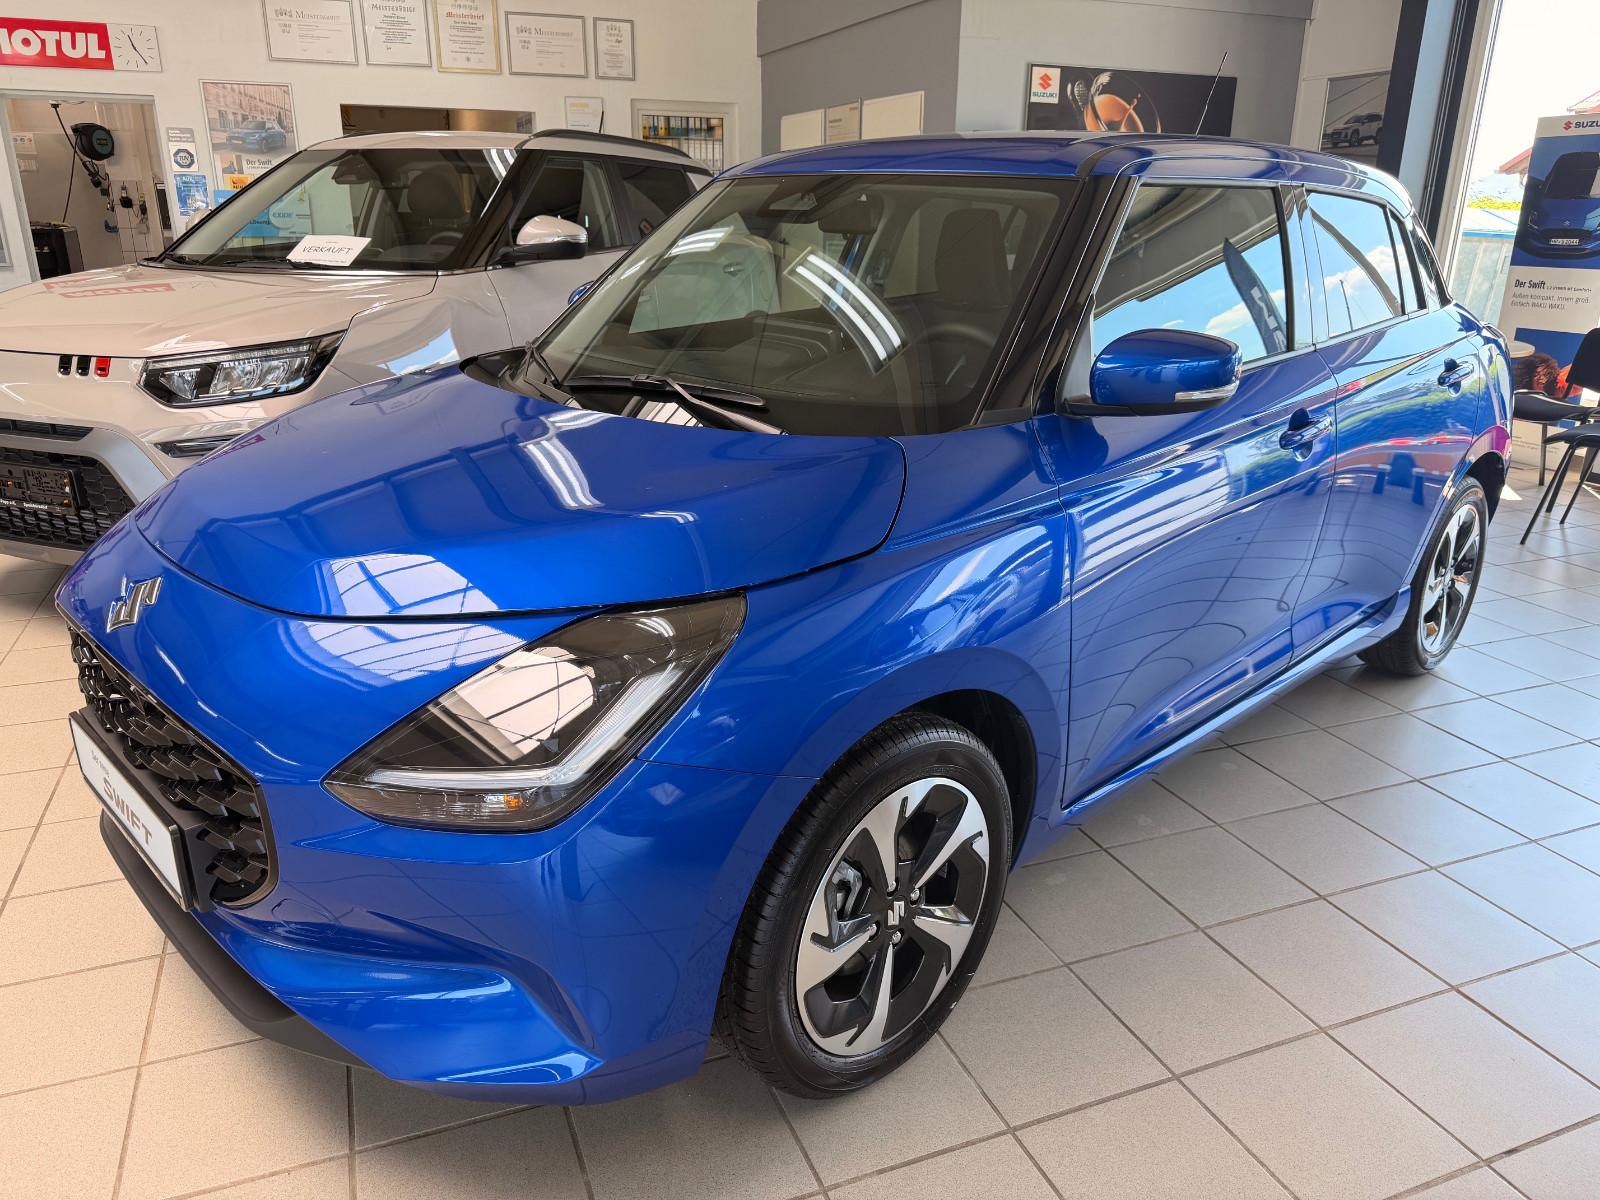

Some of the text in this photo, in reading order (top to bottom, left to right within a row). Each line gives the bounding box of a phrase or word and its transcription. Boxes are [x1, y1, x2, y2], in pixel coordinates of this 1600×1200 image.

[302, 245, 353, 254] VERKAUFT
[1514, 279, 1527, 288] Der
[1528, 280, 1546, 289] Swift
[103, 776, 153, 845] SWIFT
